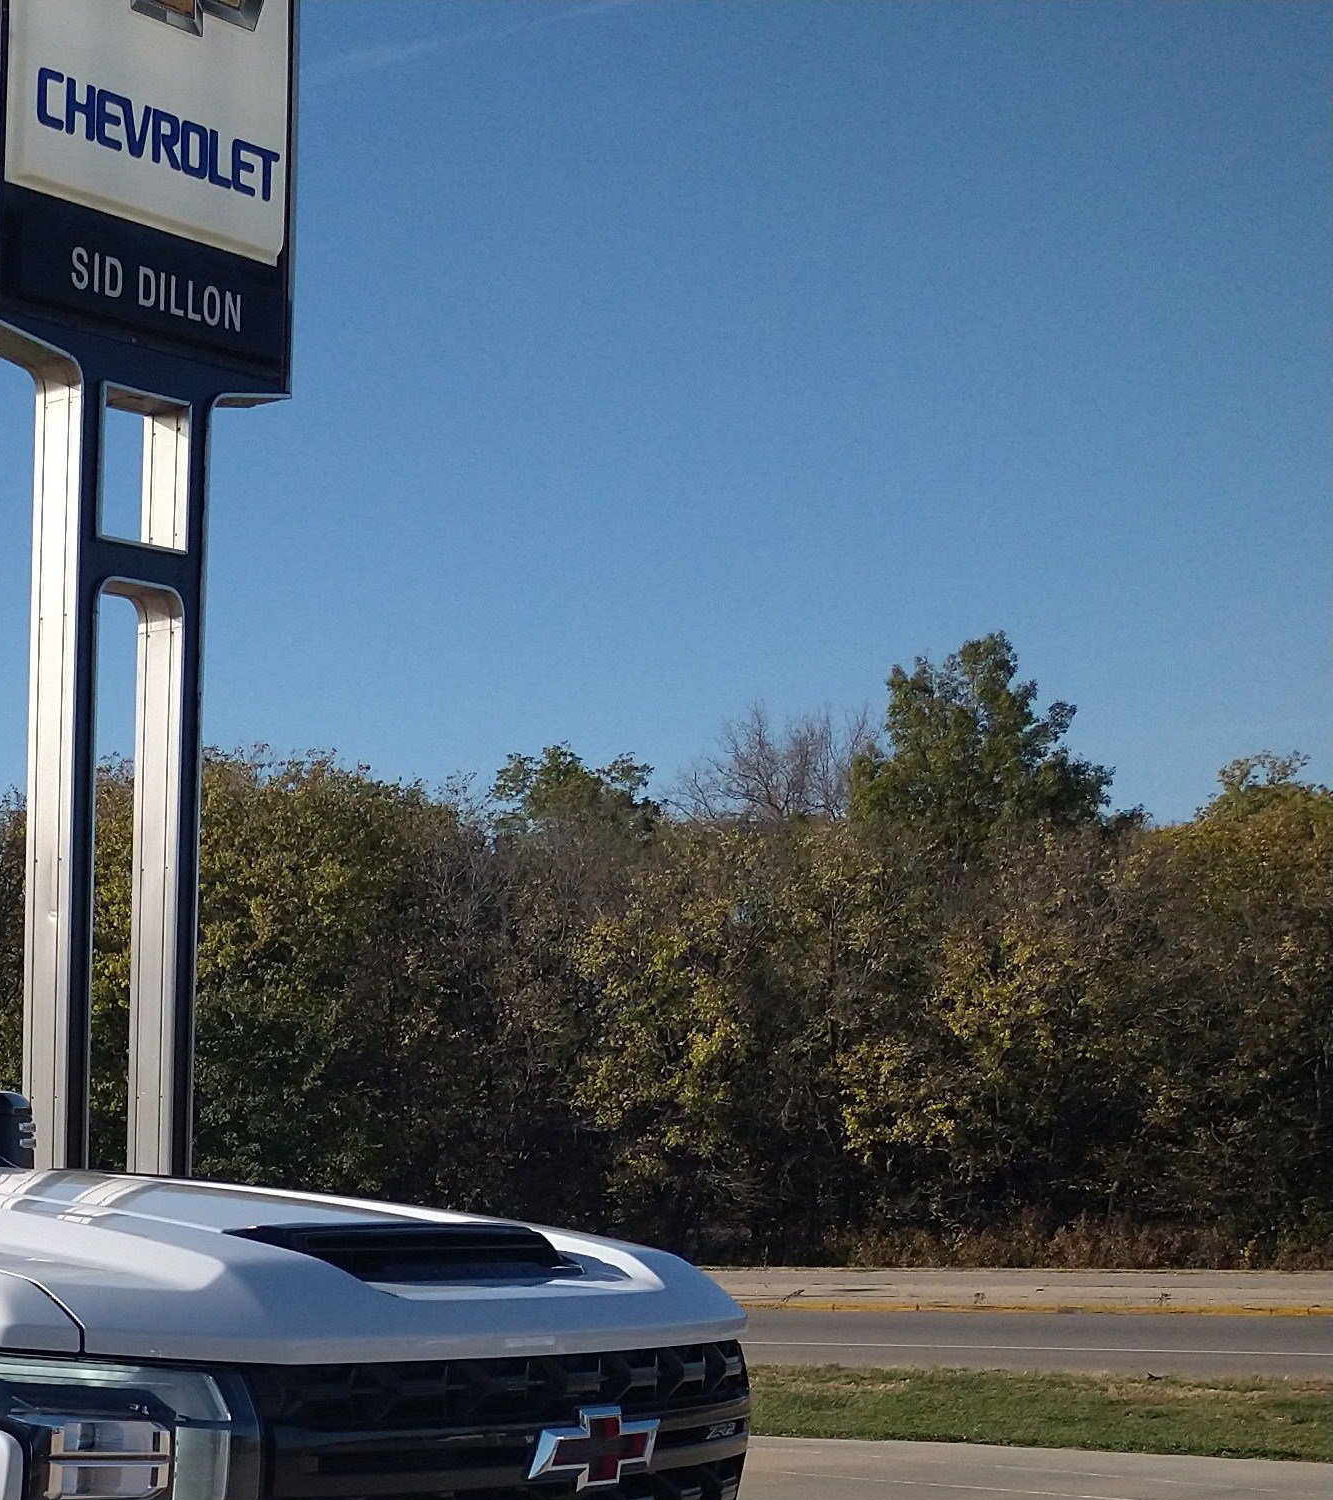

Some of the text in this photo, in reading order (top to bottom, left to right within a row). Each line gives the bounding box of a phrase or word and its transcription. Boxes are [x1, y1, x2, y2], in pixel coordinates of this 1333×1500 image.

[36, 66, 281, 202] CHEVROLET
[70, 245, 242, 333] SID DILLON
